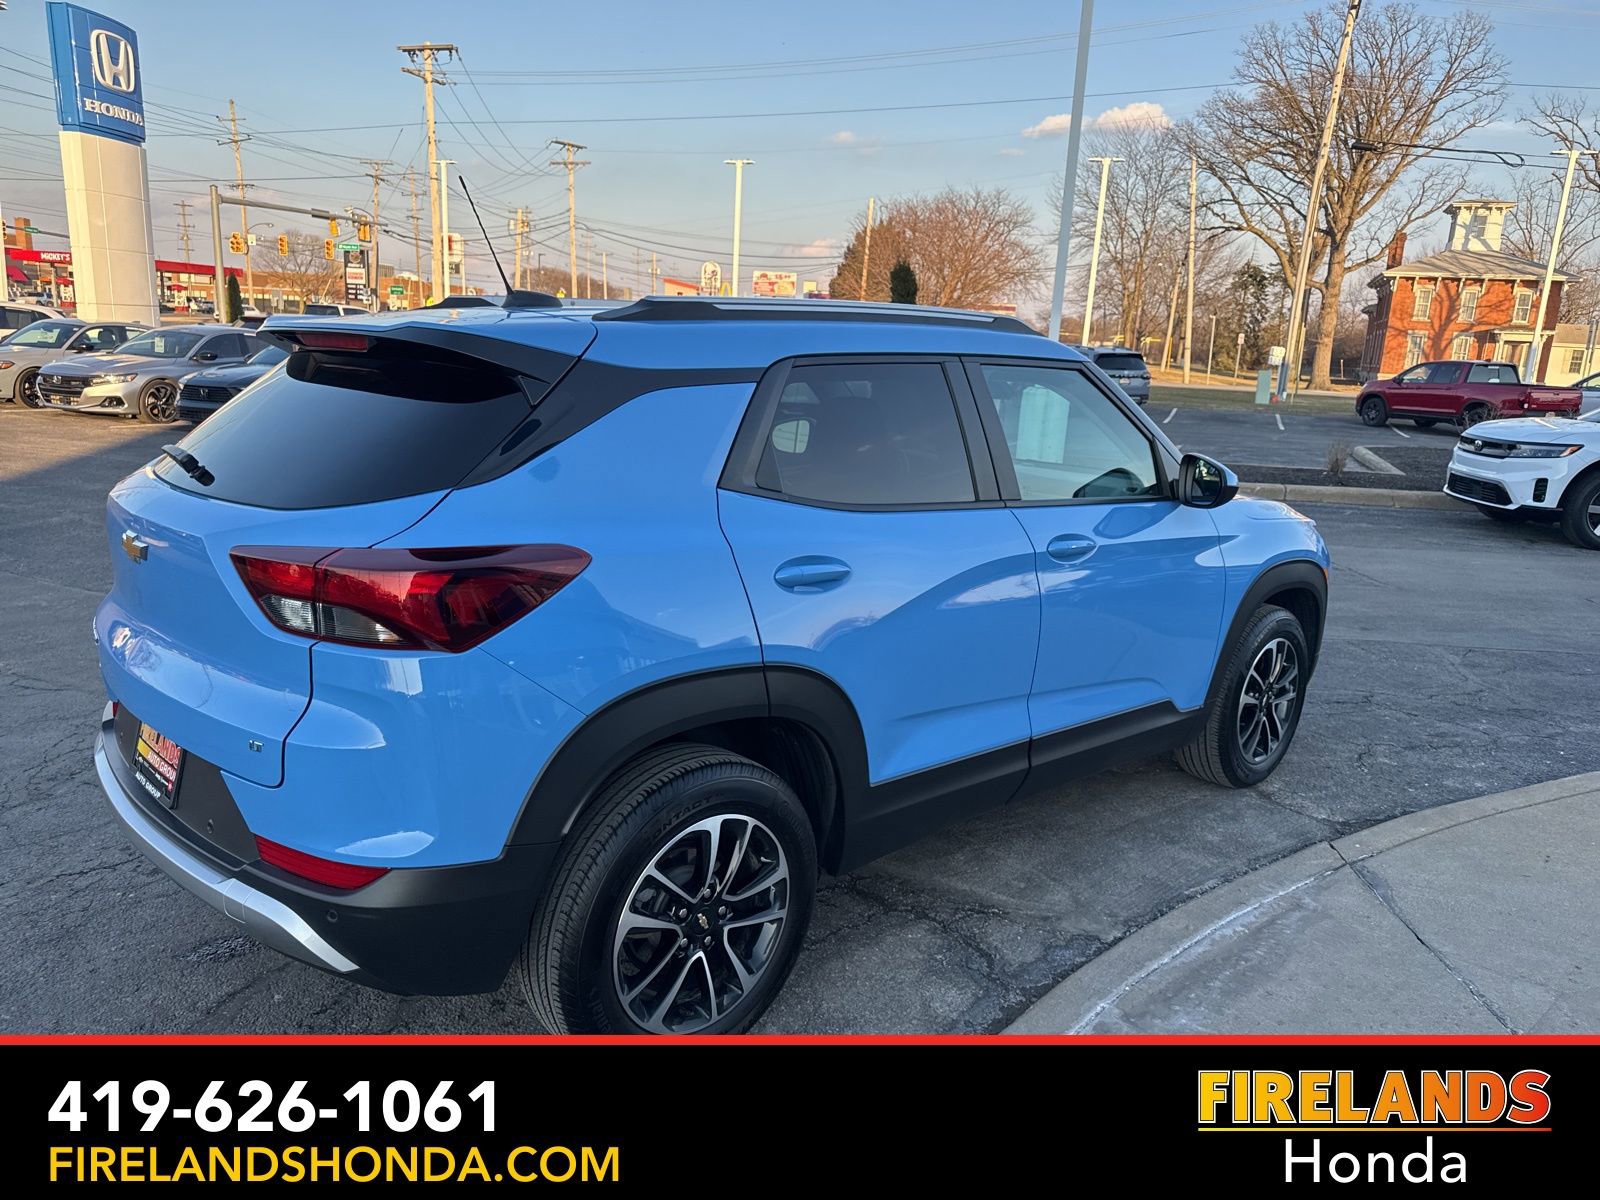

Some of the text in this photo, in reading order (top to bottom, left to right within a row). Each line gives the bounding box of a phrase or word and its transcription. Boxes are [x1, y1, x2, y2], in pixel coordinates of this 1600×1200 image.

[83, 97, 143, 126] HONDA
[147, 750, 161, 770] AUTO
[135, 771, 147, 786] AUTO
[145, 782, 161, 799] GROUP
